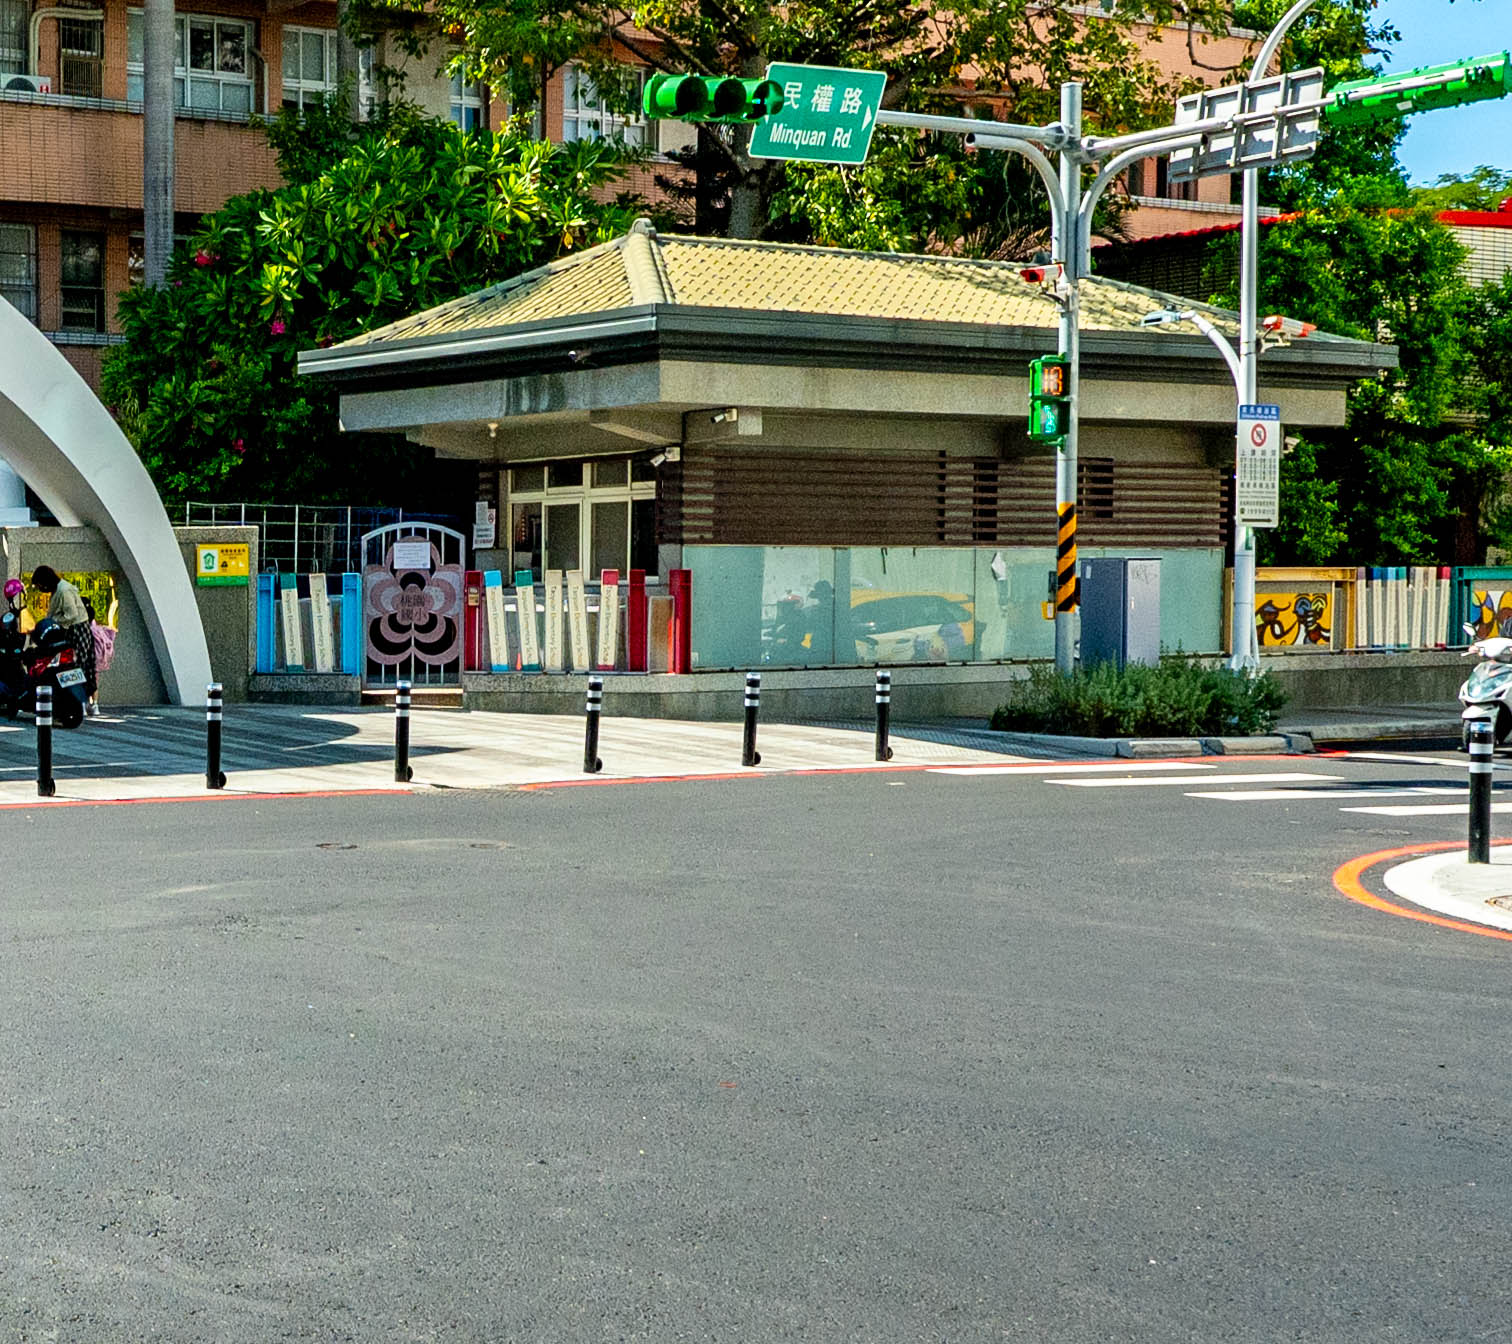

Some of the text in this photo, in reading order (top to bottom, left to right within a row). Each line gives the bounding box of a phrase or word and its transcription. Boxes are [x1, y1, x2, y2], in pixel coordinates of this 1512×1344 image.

[783, 81, 863, 115] 民權路
[769, 122, 853, 150] Minquan Rd.
